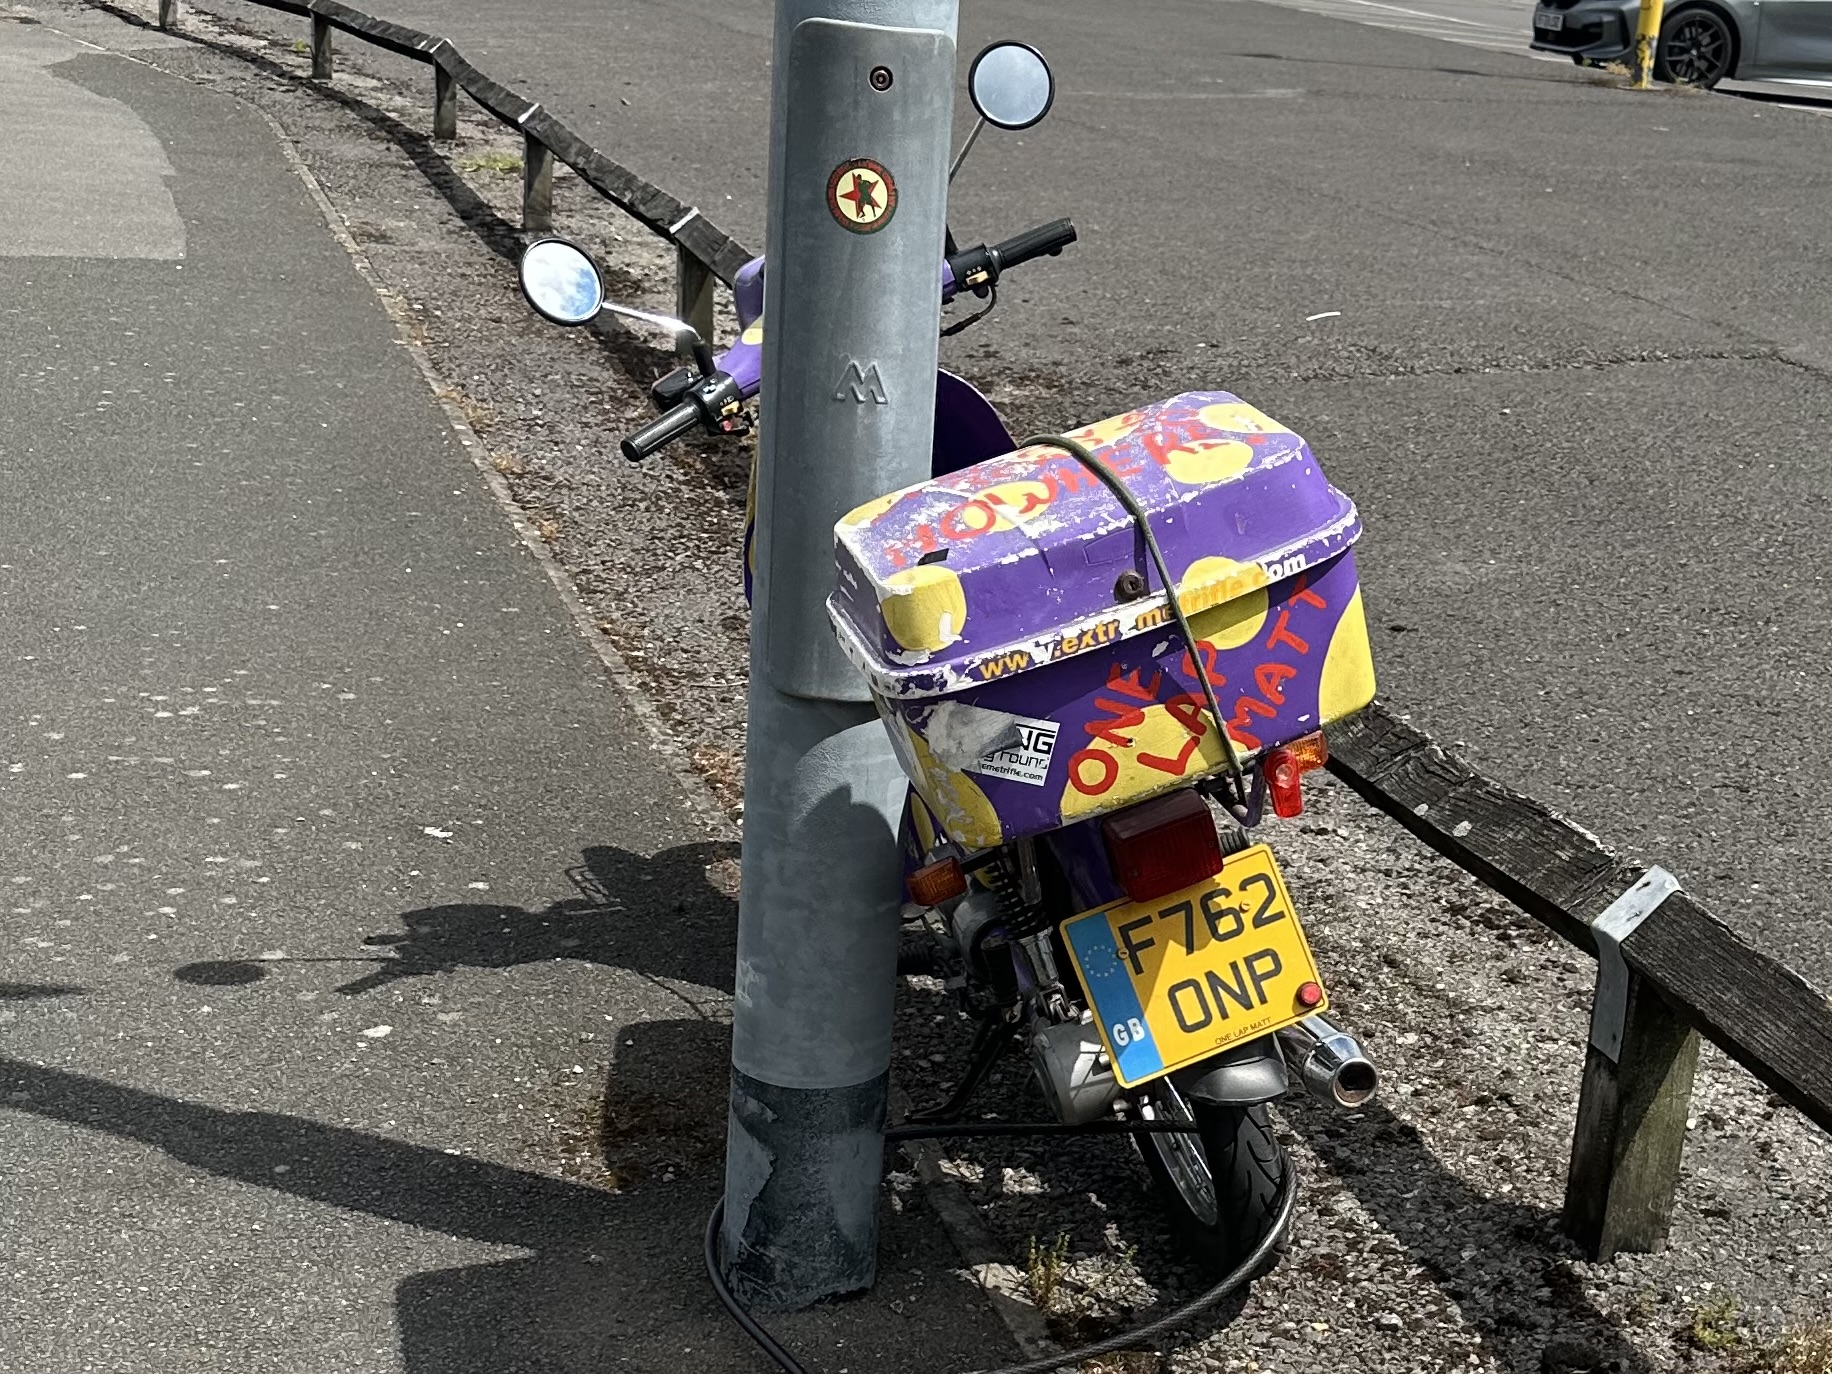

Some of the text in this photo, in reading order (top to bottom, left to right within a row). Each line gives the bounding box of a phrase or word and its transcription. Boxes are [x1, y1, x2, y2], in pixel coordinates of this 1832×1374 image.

[1137, 640, 1227, 776] LAP
[1226, 574, 1327, 751] MATT
[1069, 663, 1163, 795] ONE
[1118, 872, 1286, 975] F762
[1112, 1017, 1145, 1046] GB
[1168, 947, 1283, 1034] ONP
[1215, 1017, 1271, 1045] ONE LAP MATT
